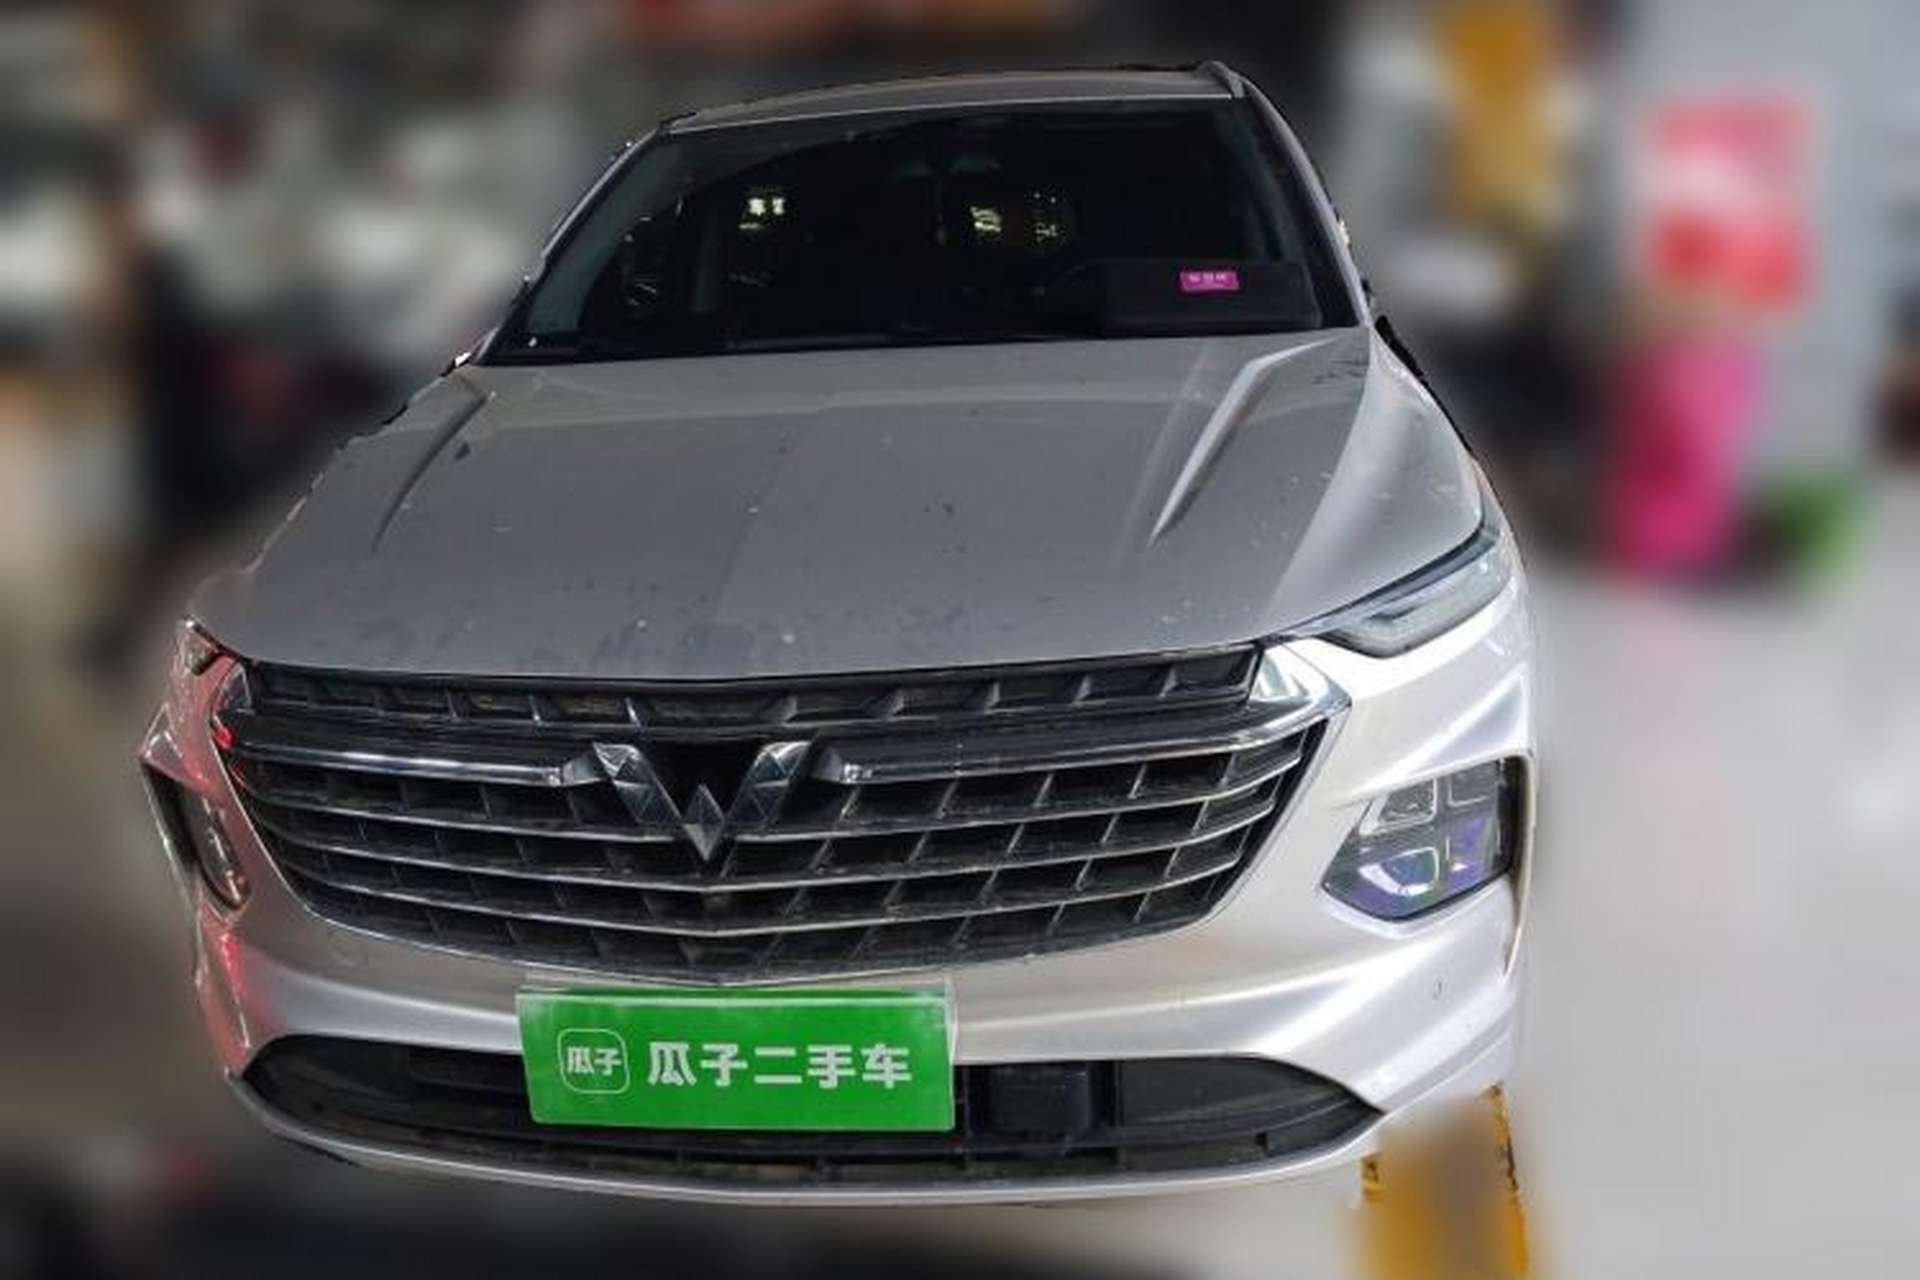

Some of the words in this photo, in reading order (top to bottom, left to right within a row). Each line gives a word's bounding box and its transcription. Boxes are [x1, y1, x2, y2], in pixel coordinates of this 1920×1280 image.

[566, 1046, 623, 1076] 瓜子
[647, 1041, 913, 1089] 瓜子二手车
